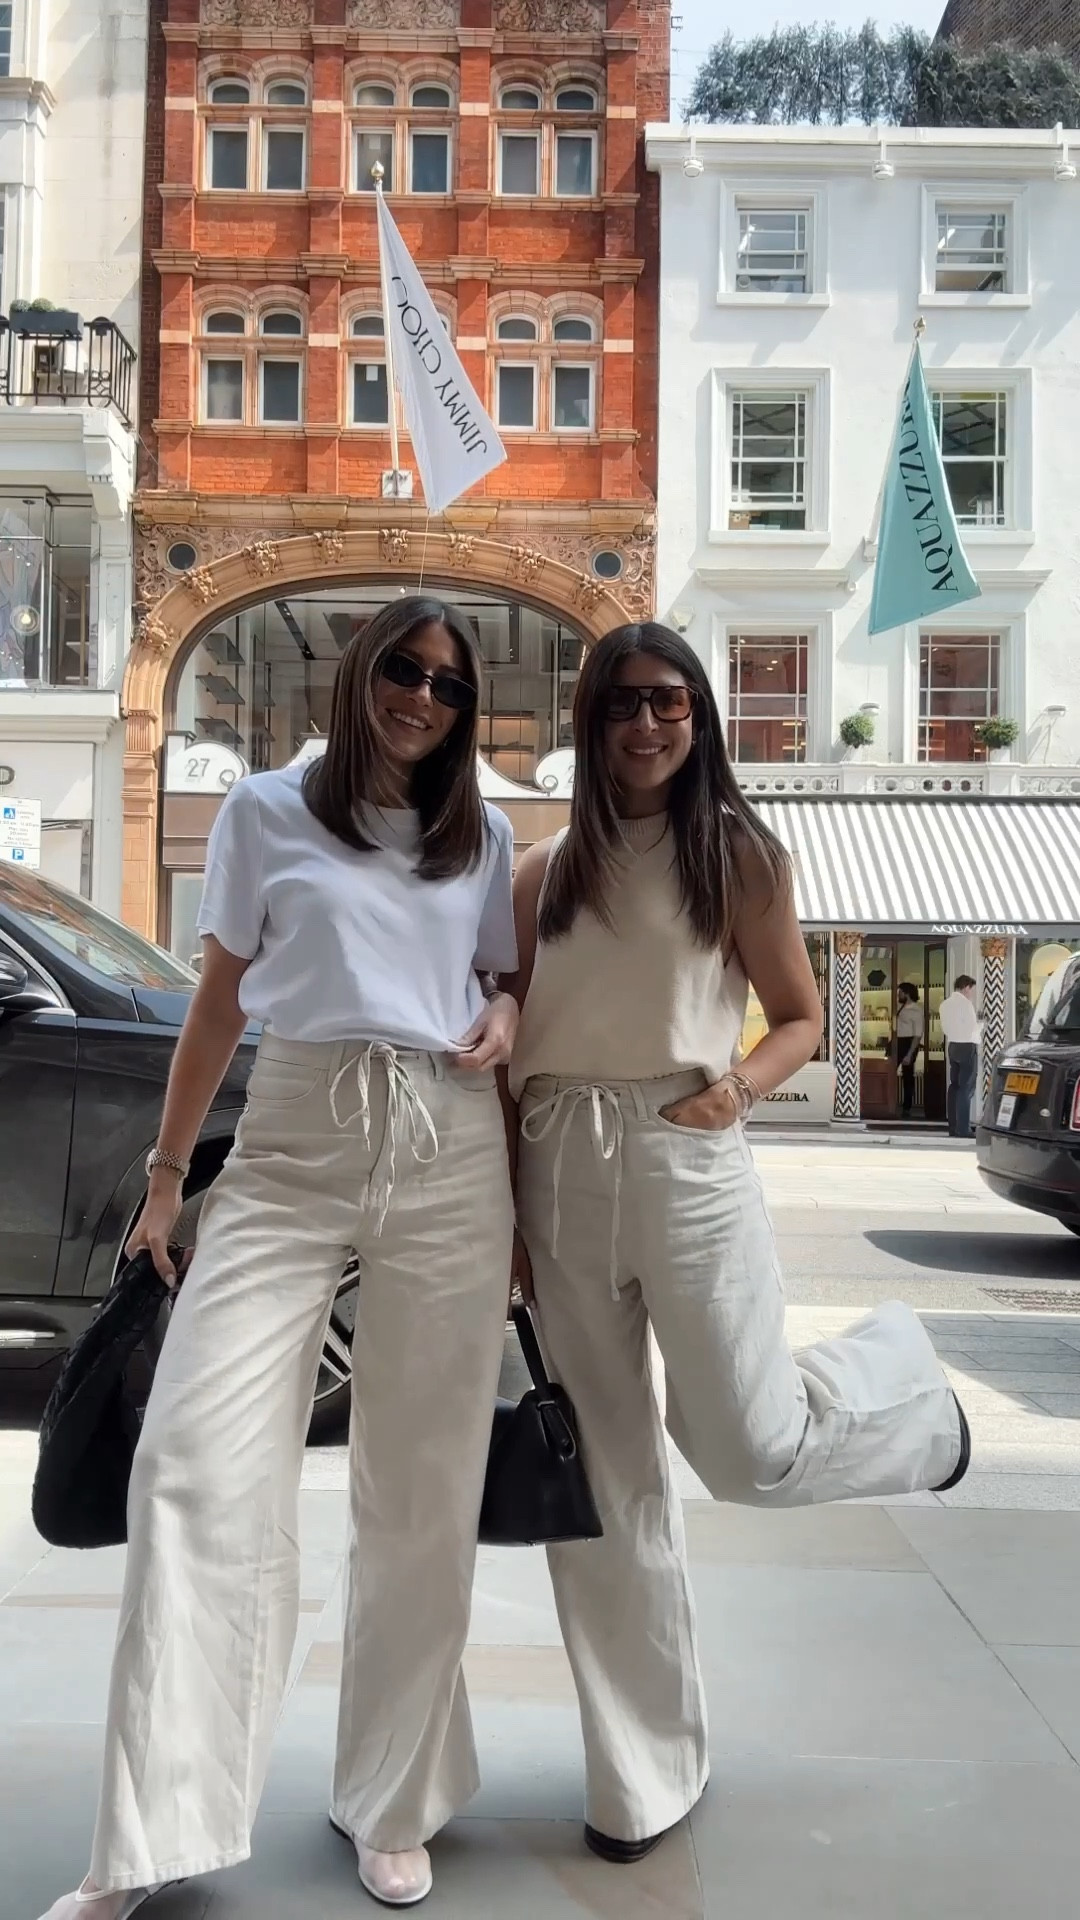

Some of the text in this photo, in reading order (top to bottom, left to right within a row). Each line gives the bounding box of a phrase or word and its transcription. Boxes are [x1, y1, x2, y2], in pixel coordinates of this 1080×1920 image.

[435, 377, 488, 454] JIMMY
[187, 757, 210, 777] 27
[931, 924, 1029, 935] AQUAZZURA
